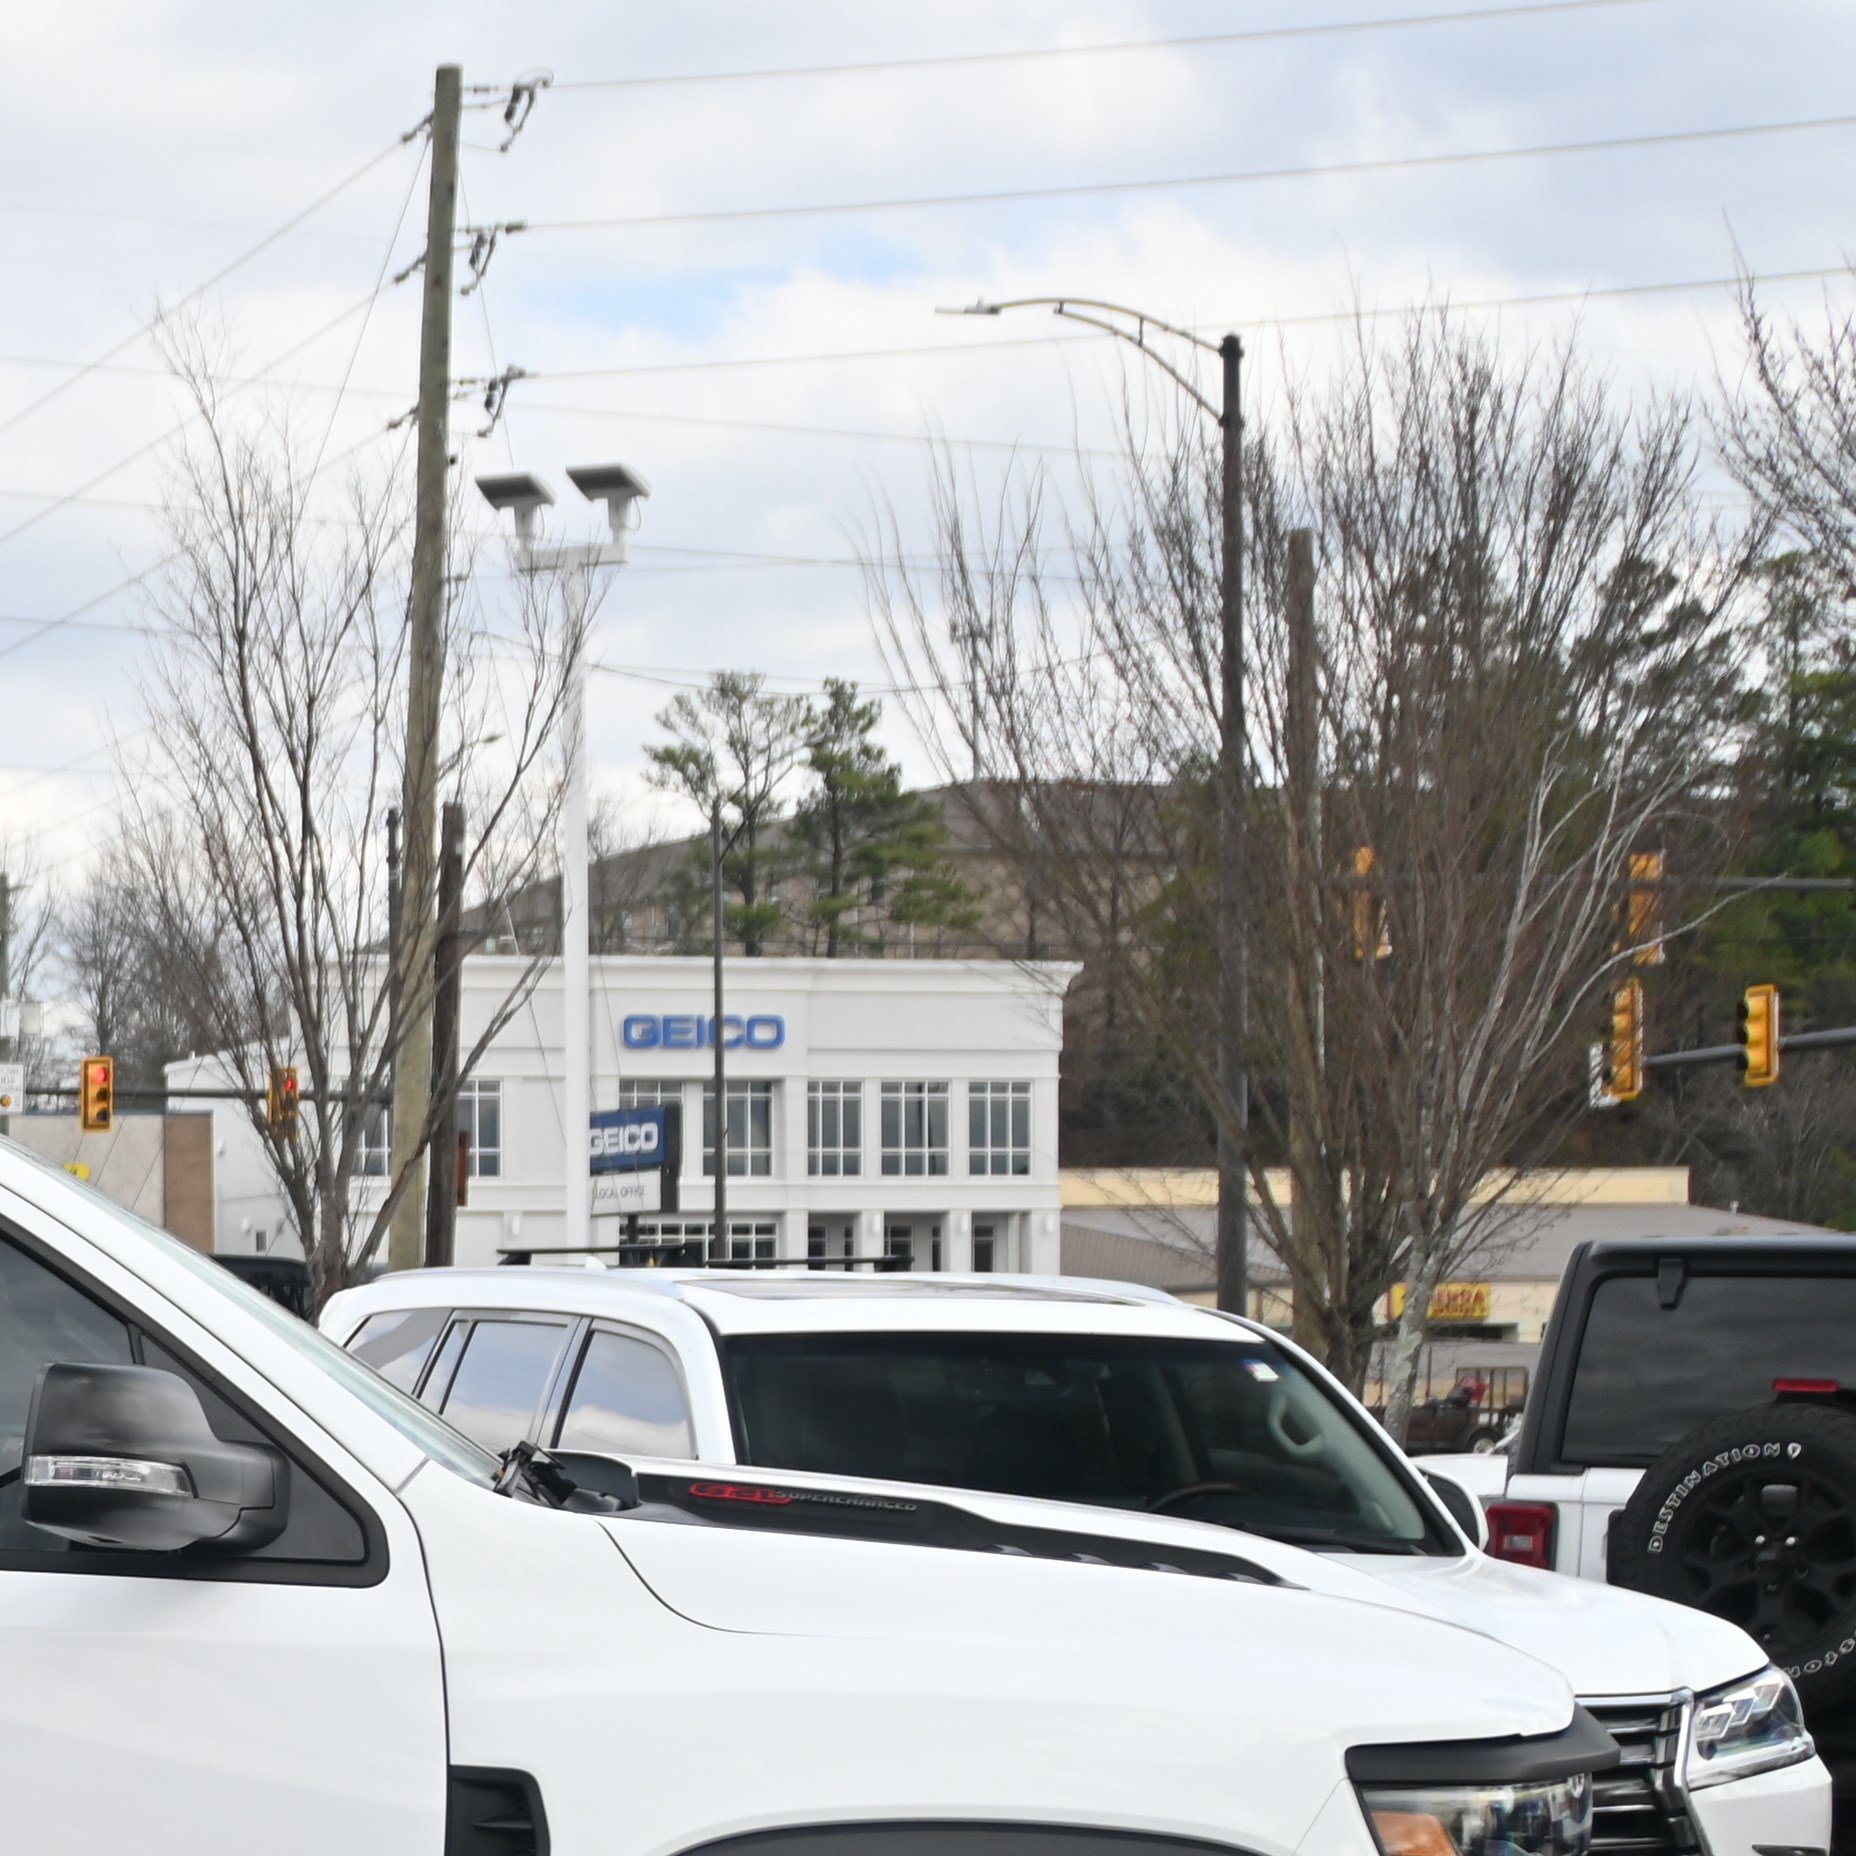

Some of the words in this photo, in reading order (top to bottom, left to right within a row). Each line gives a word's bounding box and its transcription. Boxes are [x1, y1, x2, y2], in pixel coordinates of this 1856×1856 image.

[622, 1013, 787, 1051] GEICO
[589, 1122, 659, 1155] GEICO
[776, 1490, 918, 1512] SUPERCHARGED
[1647, 1442, 1781, 1553] DESTINATION
